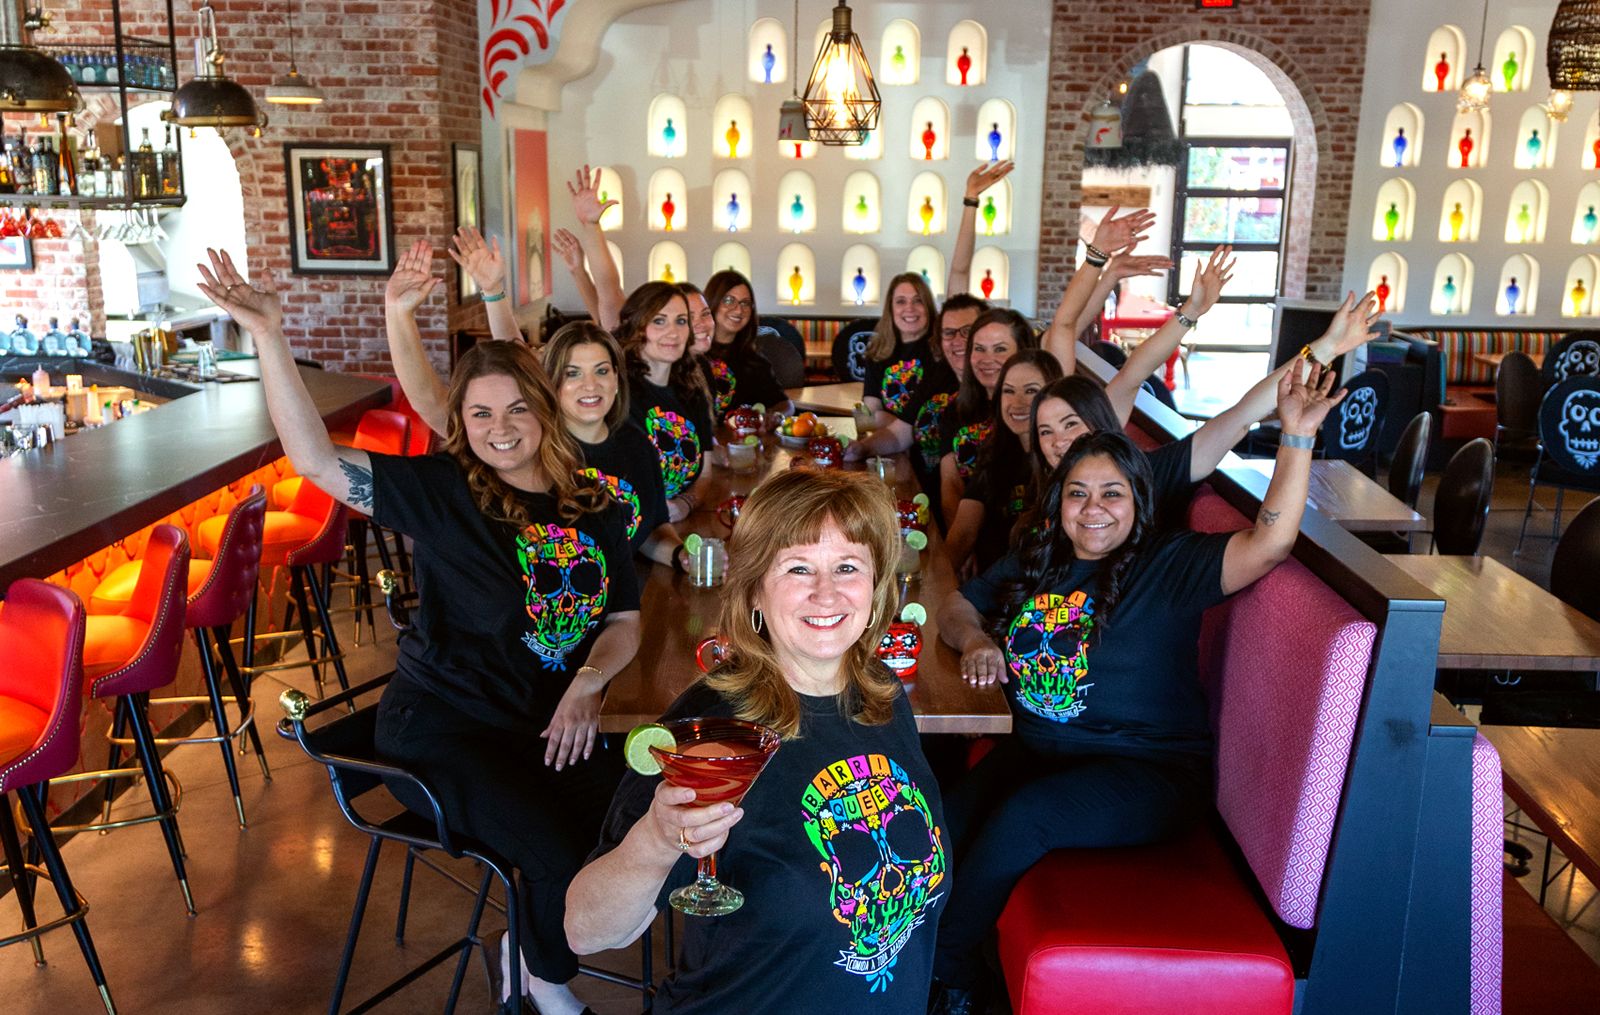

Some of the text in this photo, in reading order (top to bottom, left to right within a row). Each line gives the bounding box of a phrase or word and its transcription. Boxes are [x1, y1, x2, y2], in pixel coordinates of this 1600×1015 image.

[541, 541, 583, 557] UEEN
[1023, 592, 1095, 612] BARIO
[1032, 608, 1079, 622] QEEN
[803, 755, 906, 811] BARRIO
[831, 779, 898, 819] QUEEN
